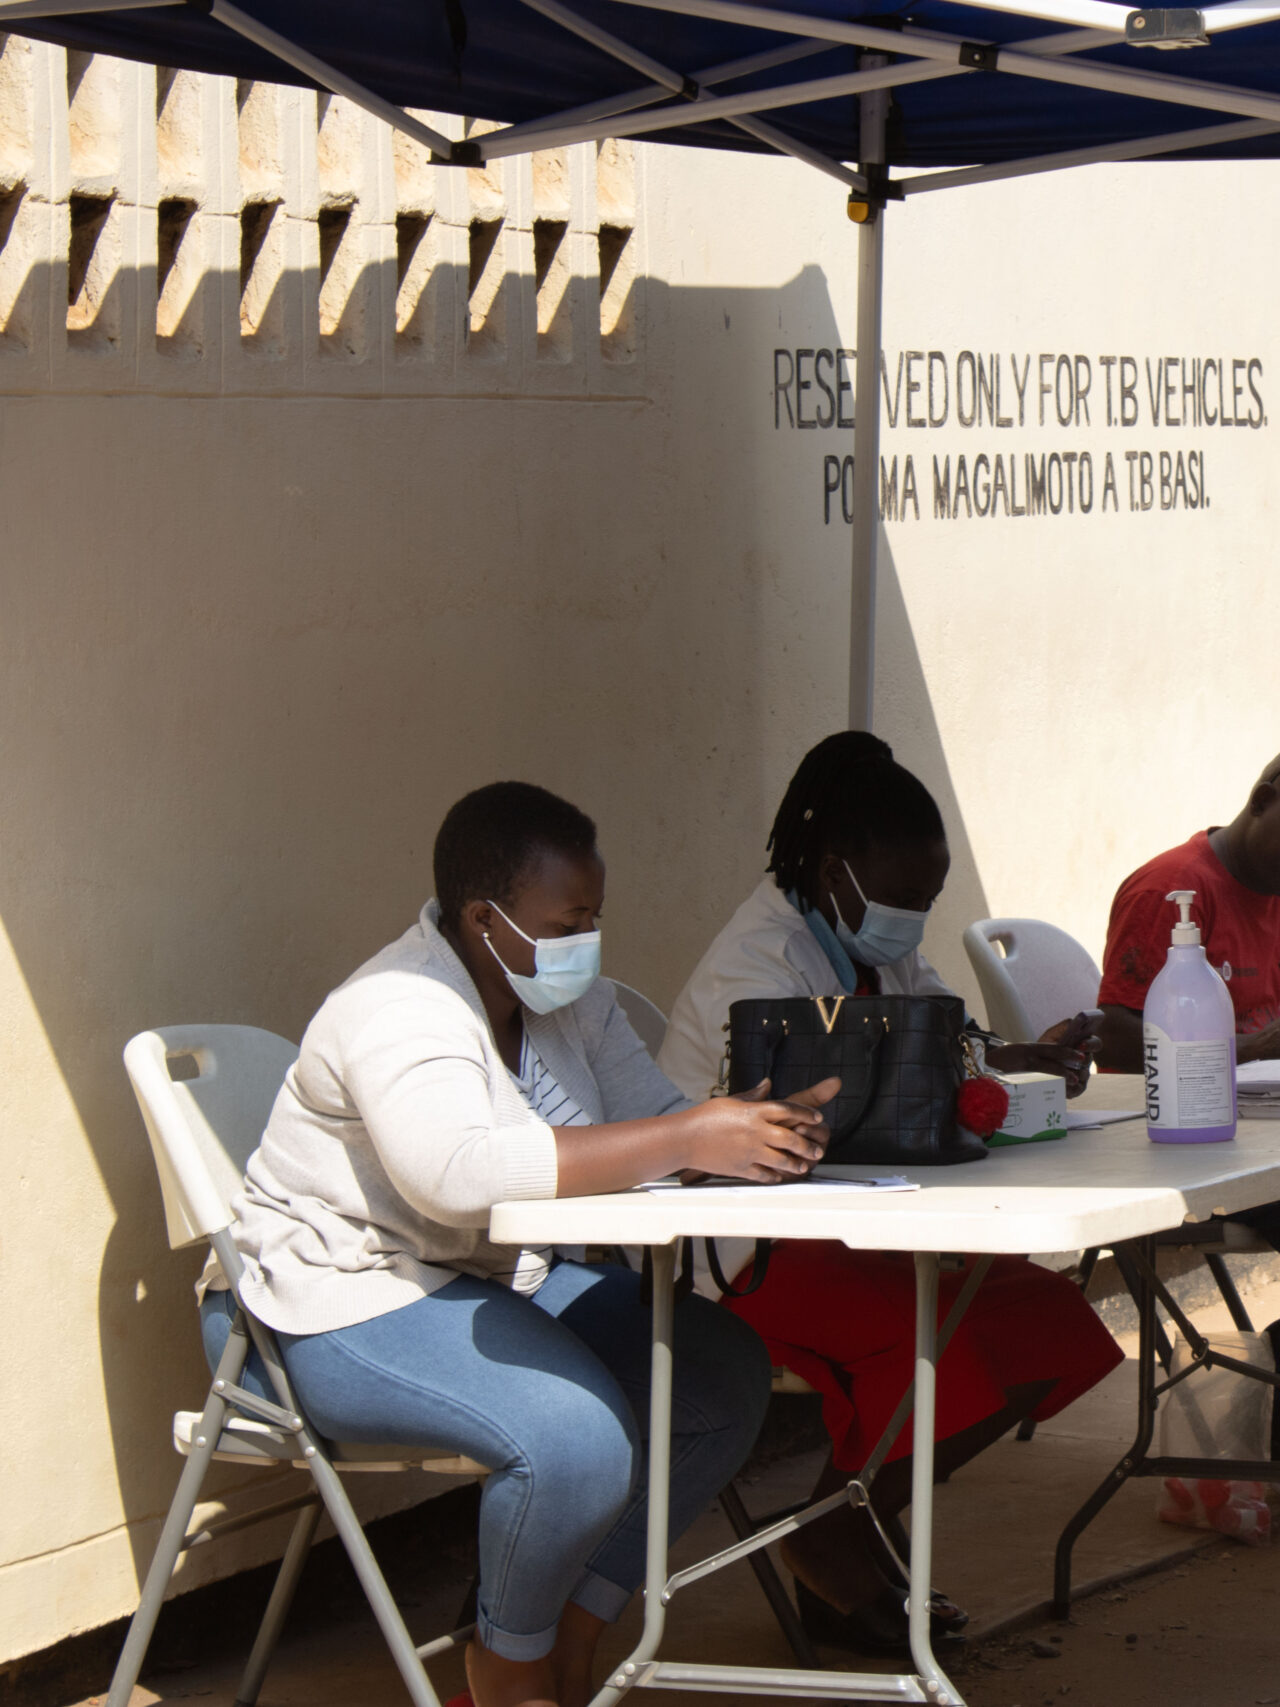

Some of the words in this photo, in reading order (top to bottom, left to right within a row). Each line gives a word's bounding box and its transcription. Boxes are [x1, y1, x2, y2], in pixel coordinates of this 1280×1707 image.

[774, 348, 949, 430] RESEVED
[957, 350, 1031, 429] ONLY
[1038, 353, 1092, 428] FOR
[1099, 355, 1139, 428] T.B
[1145, 356, 1268, 430] VEHICLES.
[824, 454, 920, 525] POMA
[932, 451, 1094, 520] MAGALIMOTO
[1102, 451, 1119, 513] A
[1124, 450, 1154, 513] T.B
[1159, 449, 1211, 511] BASI.
[1146, 1044, 1160, 1122] HAND
